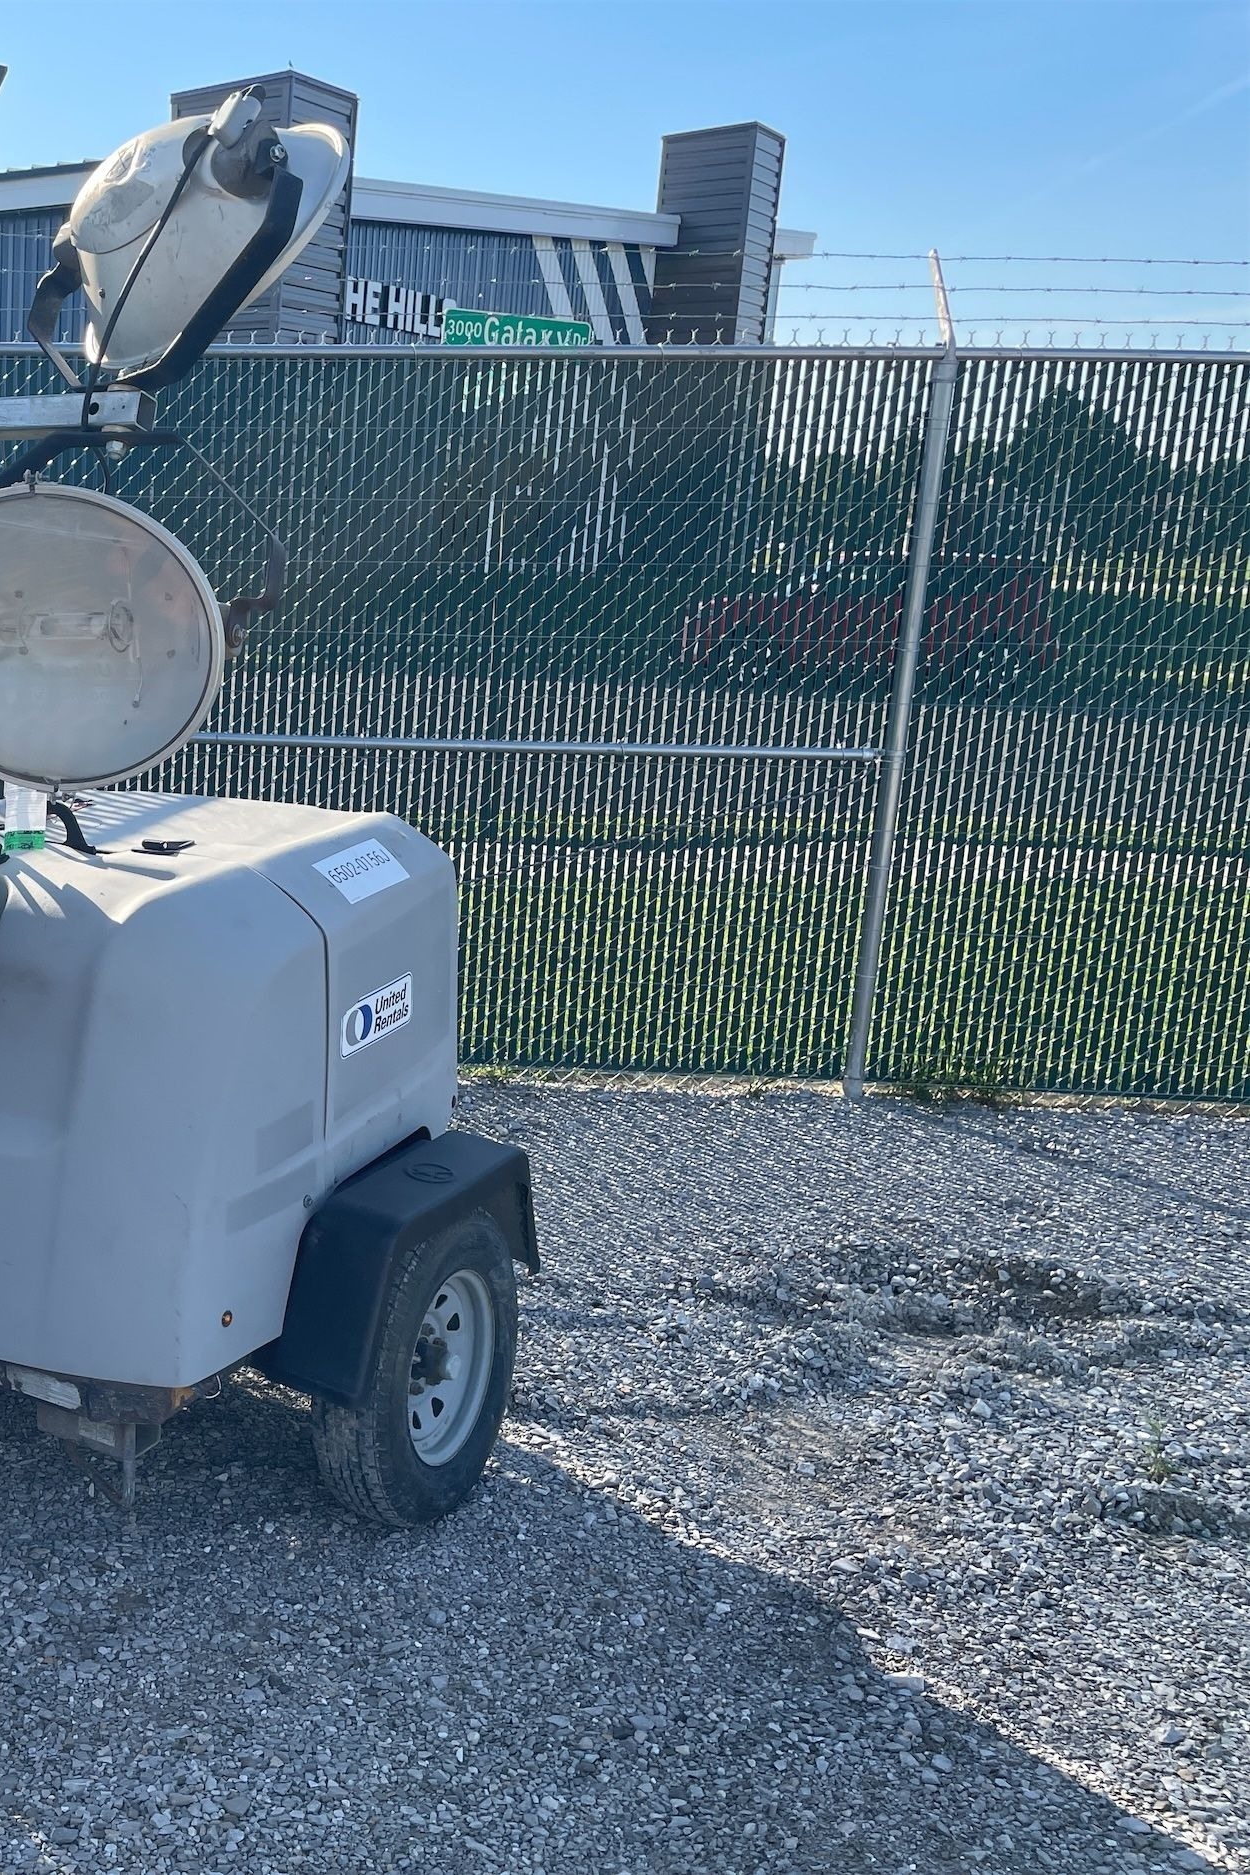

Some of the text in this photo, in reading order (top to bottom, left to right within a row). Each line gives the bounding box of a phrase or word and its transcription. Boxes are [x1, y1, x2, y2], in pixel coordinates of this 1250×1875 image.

[344, 275, 456, 338] HE HILL
[447, 319, 482, 338] 3000
[573, 332, 588, 346] Dr
[327, 848, 391, 884] 6502-0156J
[374, 983, 407, 1015] United
[373, 1002, 409, 1034] Rentals
